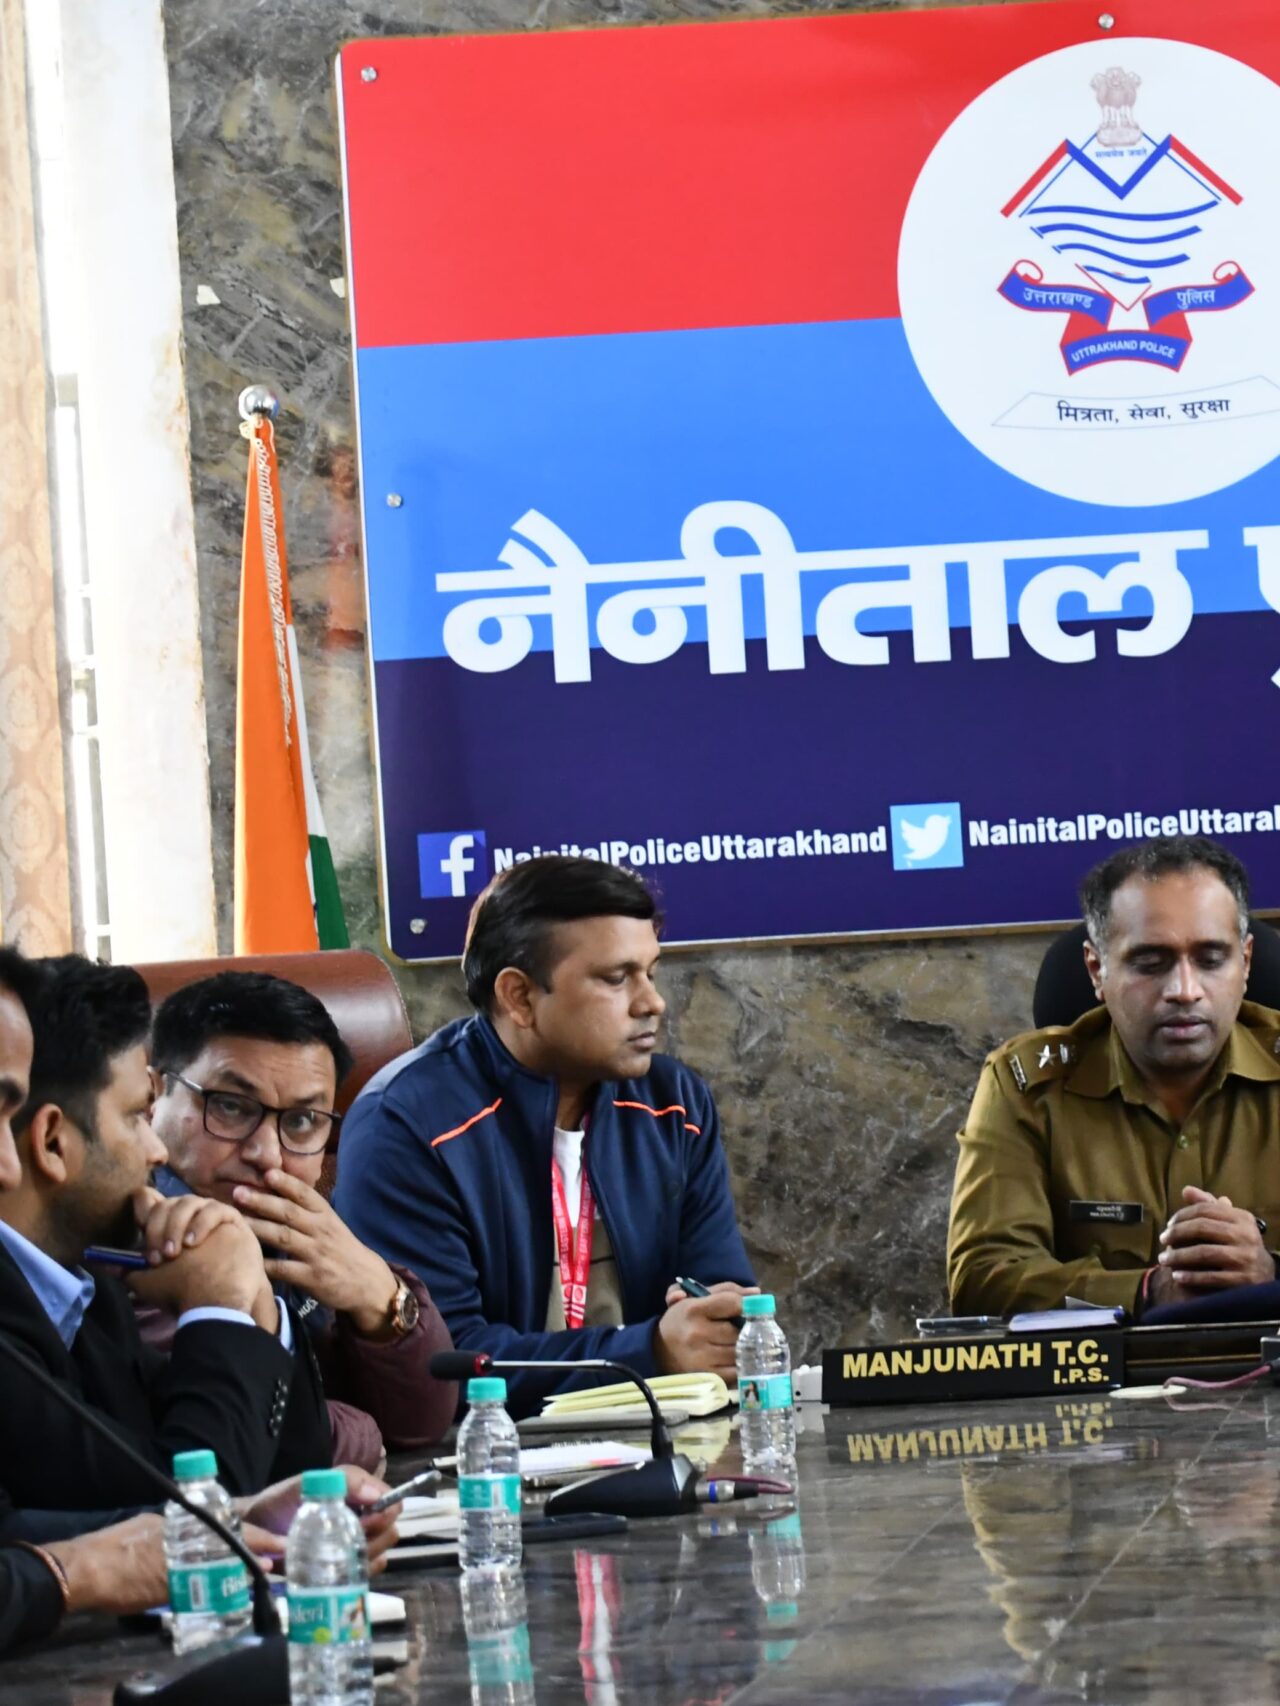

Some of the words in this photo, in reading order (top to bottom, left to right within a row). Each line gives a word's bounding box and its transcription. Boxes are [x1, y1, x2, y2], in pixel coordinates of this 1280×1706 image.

[1023, 287, 1095, 309] उत्तराखण्ड
[1176, 288, 1216, 310] पुलिस
[1071, 340, 1138, 362] UTTRAKHAND
[1139, 340, 1176, 359] POLICE
[1057, 400, 1119, 423] मित्रता,
[1128, 403, 1171, 420] सेवा,
[1180, 399, 1230, 419] सुरक्षा
[435, 500, 1210, 684] नैनीताल
[494, 826, 887, 875] NaiitalPoliceUttarakhand
[843, 1342, 1042, 1378] MANJUNATH
[1051, 1339, 1109, 1366] T.C.
[1053, 1367, 1110, 1384] I.P.S.
